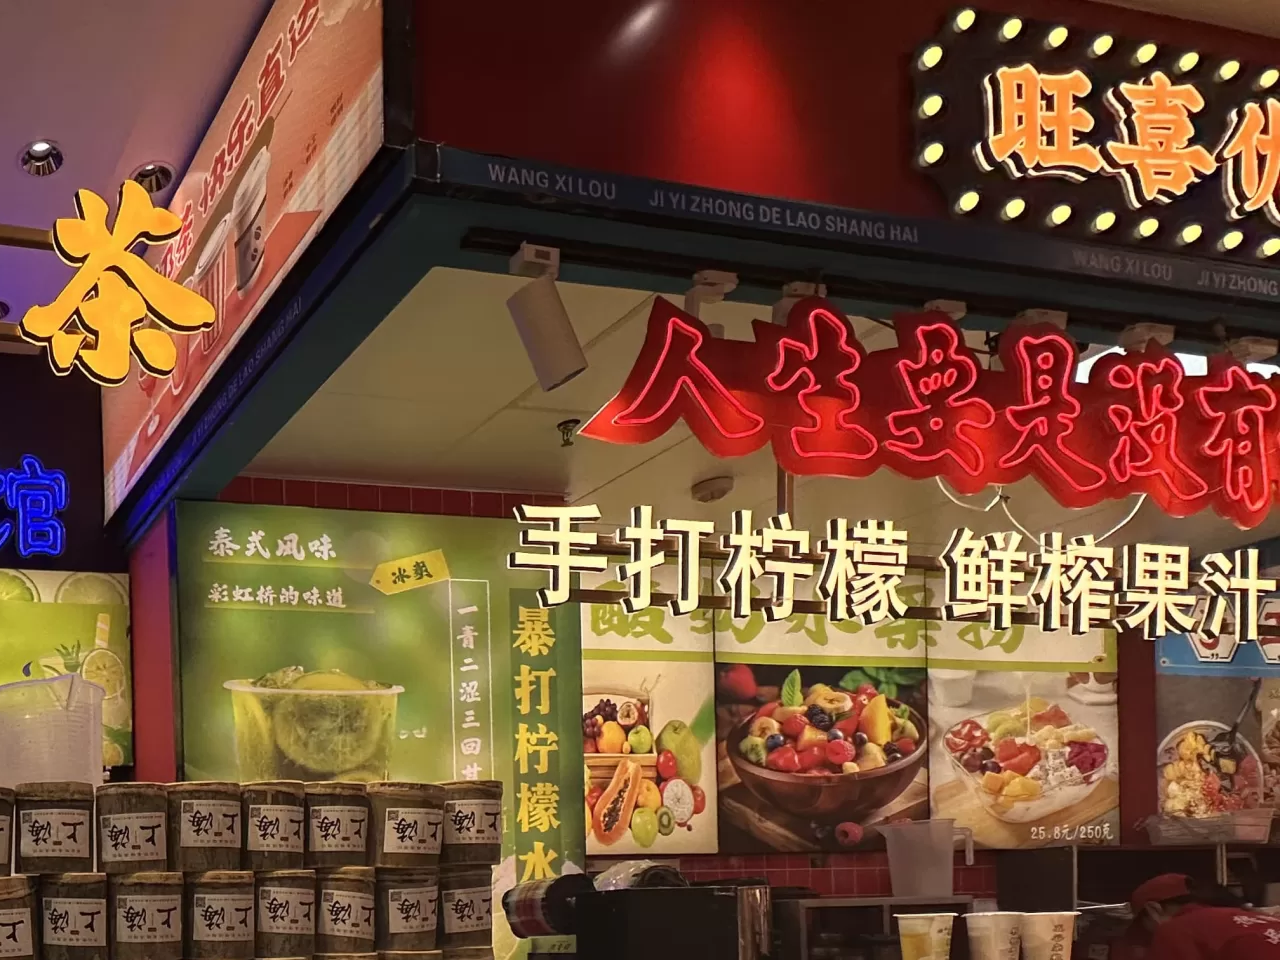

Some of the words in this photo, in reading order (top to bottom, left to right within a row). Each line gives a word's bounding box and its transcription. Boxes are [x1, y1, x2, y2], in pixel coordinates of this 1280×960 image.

[488, 164, 549, 188] WANG
[555, 174, 573, 192] XI
[579, 178, 616, 200] LOU
[649, 190, 664, 207] JI
[669, 192, 686, 210] YI
[690, 195, 754, 221] ZHONG
[760, 207, 782, 225] DE
[786, 210, 820, 230] LAO
[825, 215, 885, 240] SHANG
[890, 224, 918, 243] HAI
[1071, 250, 1120, 272] WANG
[1144, 259, 1171, 281] LOU
[1229, 274, 1279, 296] ZHONG
[208, 527, 337, 562] 泰式风味
[391, 559, 433, 585] 冰爽
[507, 502, 908, 626] 手打柠檬
[939, 526, 1278, 646] 鲜榨果汁
[207, 584, 347, 609] 彩虹桥的味道
[512, 605, 560, 881] 暴打柠檬水
[1030, 823, 1115, 841] 25.8元/250克
